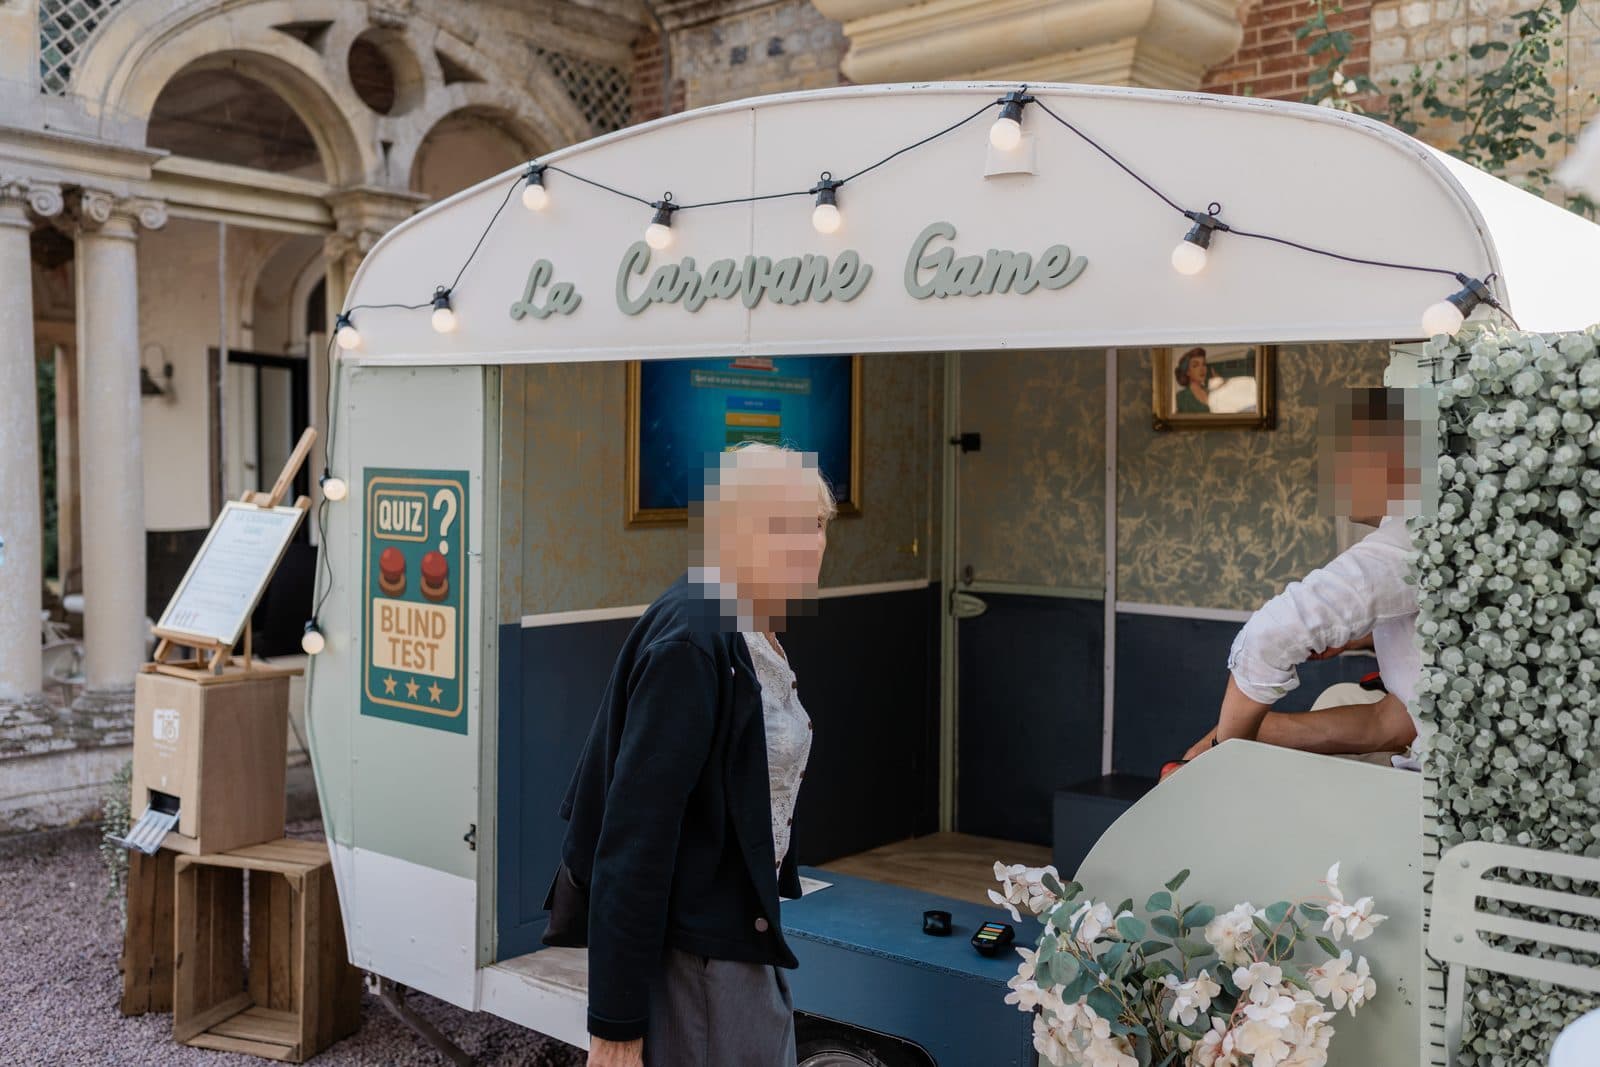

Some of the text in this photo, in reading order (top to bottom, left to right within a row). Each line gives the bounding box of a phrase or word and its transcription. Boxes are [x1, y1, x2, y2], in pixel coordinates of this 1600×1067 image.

[510, 221, 1089, 320] La Caravane Game
[378, 499, 423, 533] QUIZ
[380, 604, 447, 641] BLIND
[388, 635, 439, 673] TEST
